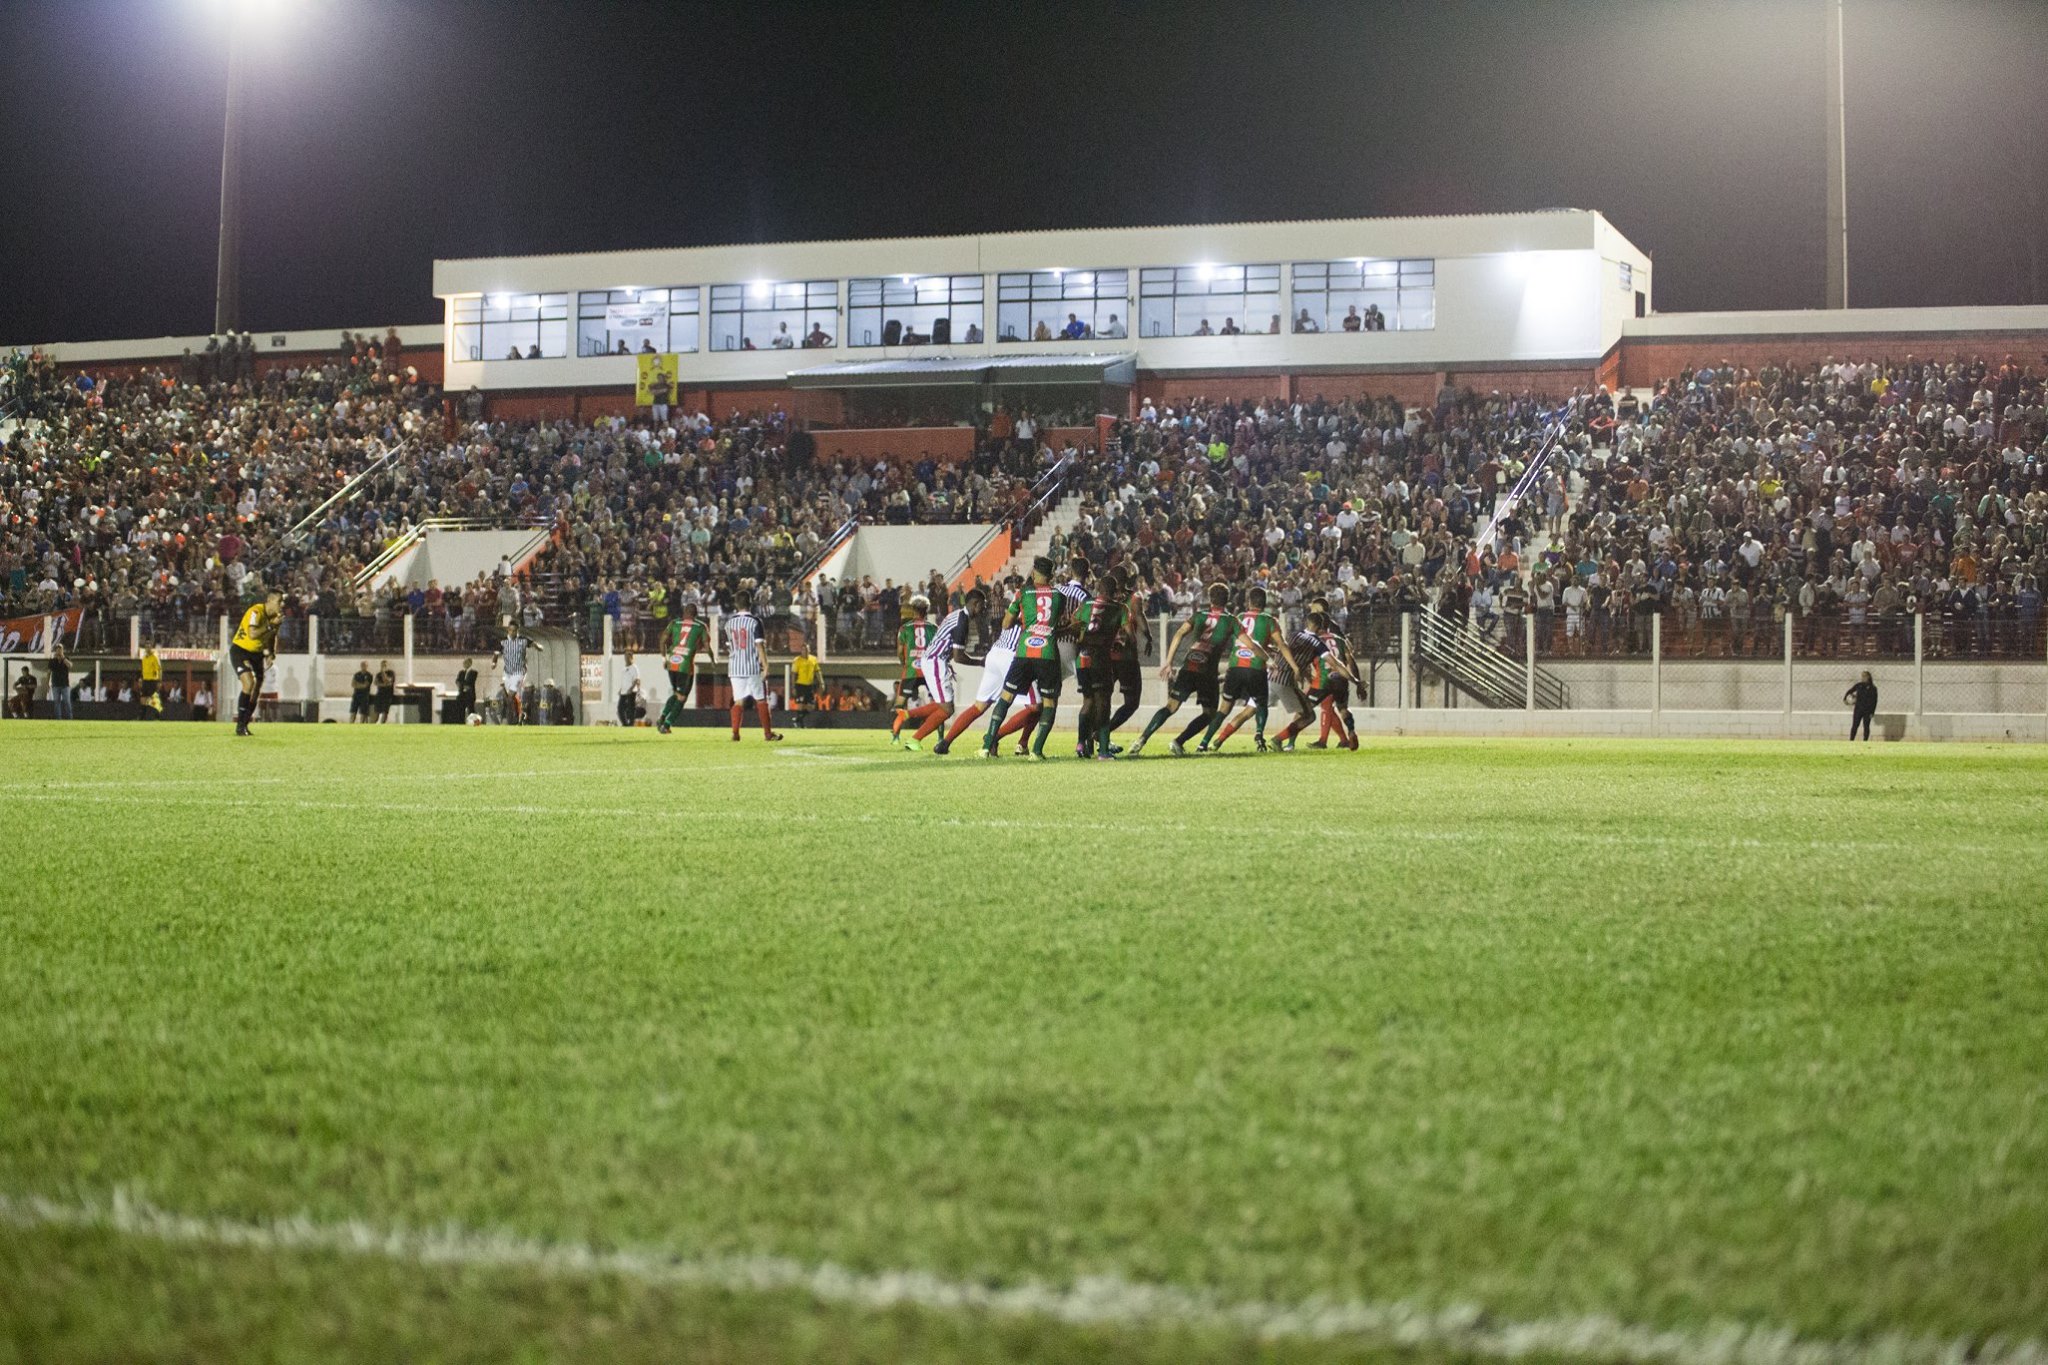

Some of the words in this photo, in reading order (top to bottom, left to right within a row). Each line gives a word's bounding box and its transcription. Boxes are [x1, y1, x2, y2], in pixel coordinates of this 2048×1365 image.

[1036, 596, 1052, 622] 3
[680, 625, 692, 646] 7
[914, 626, 926, 648] 8
[1200, 617, 1218, 641] 2
[1241, 617, 1256, 636] 9
